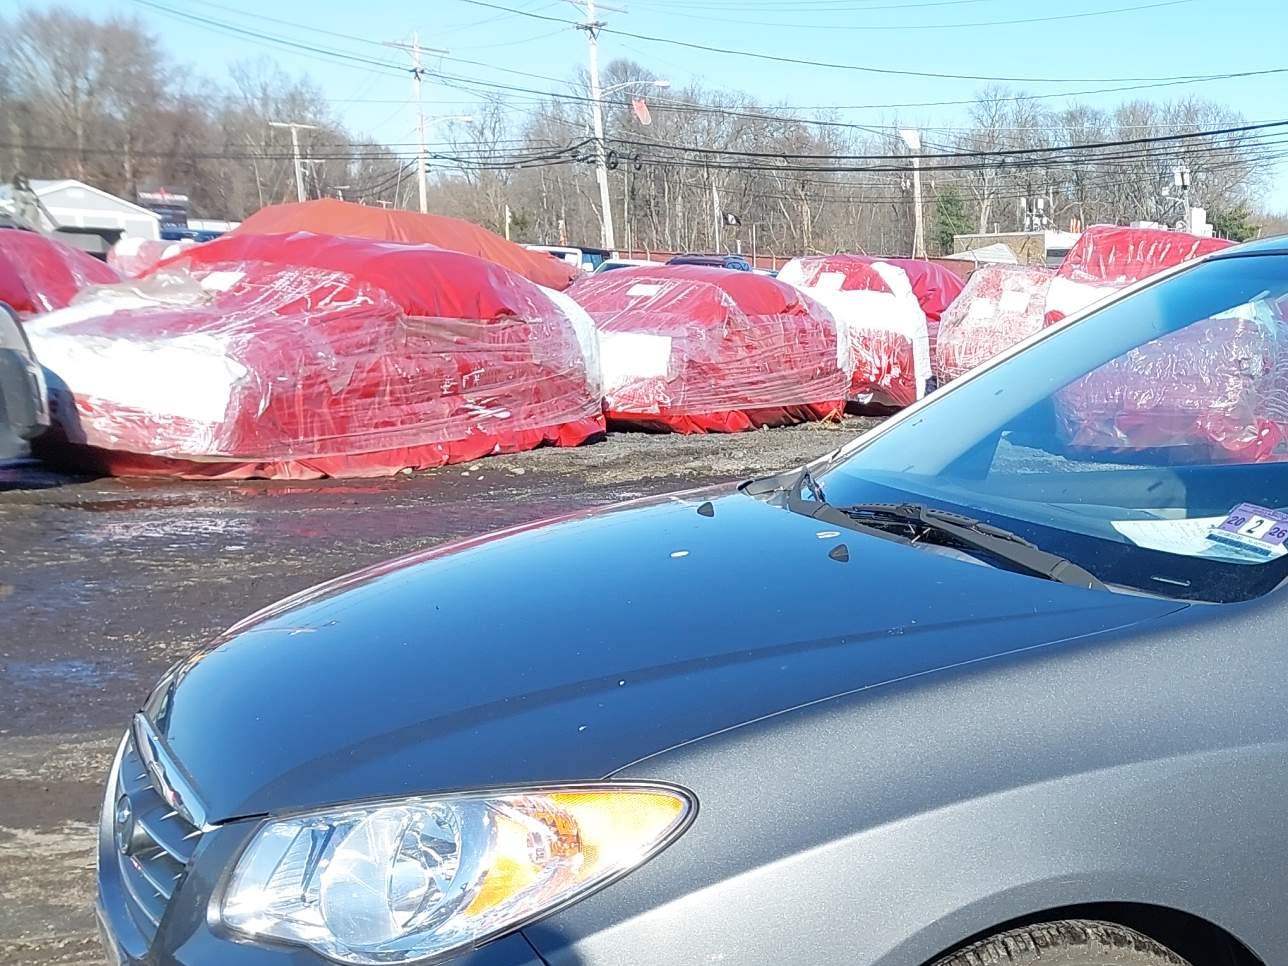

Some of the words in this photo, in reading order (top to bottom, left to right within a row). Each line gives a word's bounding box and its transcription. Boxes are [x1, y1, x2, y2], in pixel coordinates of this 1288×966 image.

[1227, 515, 1246, 527] 20
[1246, 519, 1265, 534] 2
[1268, 527, 1288, 539] 26
